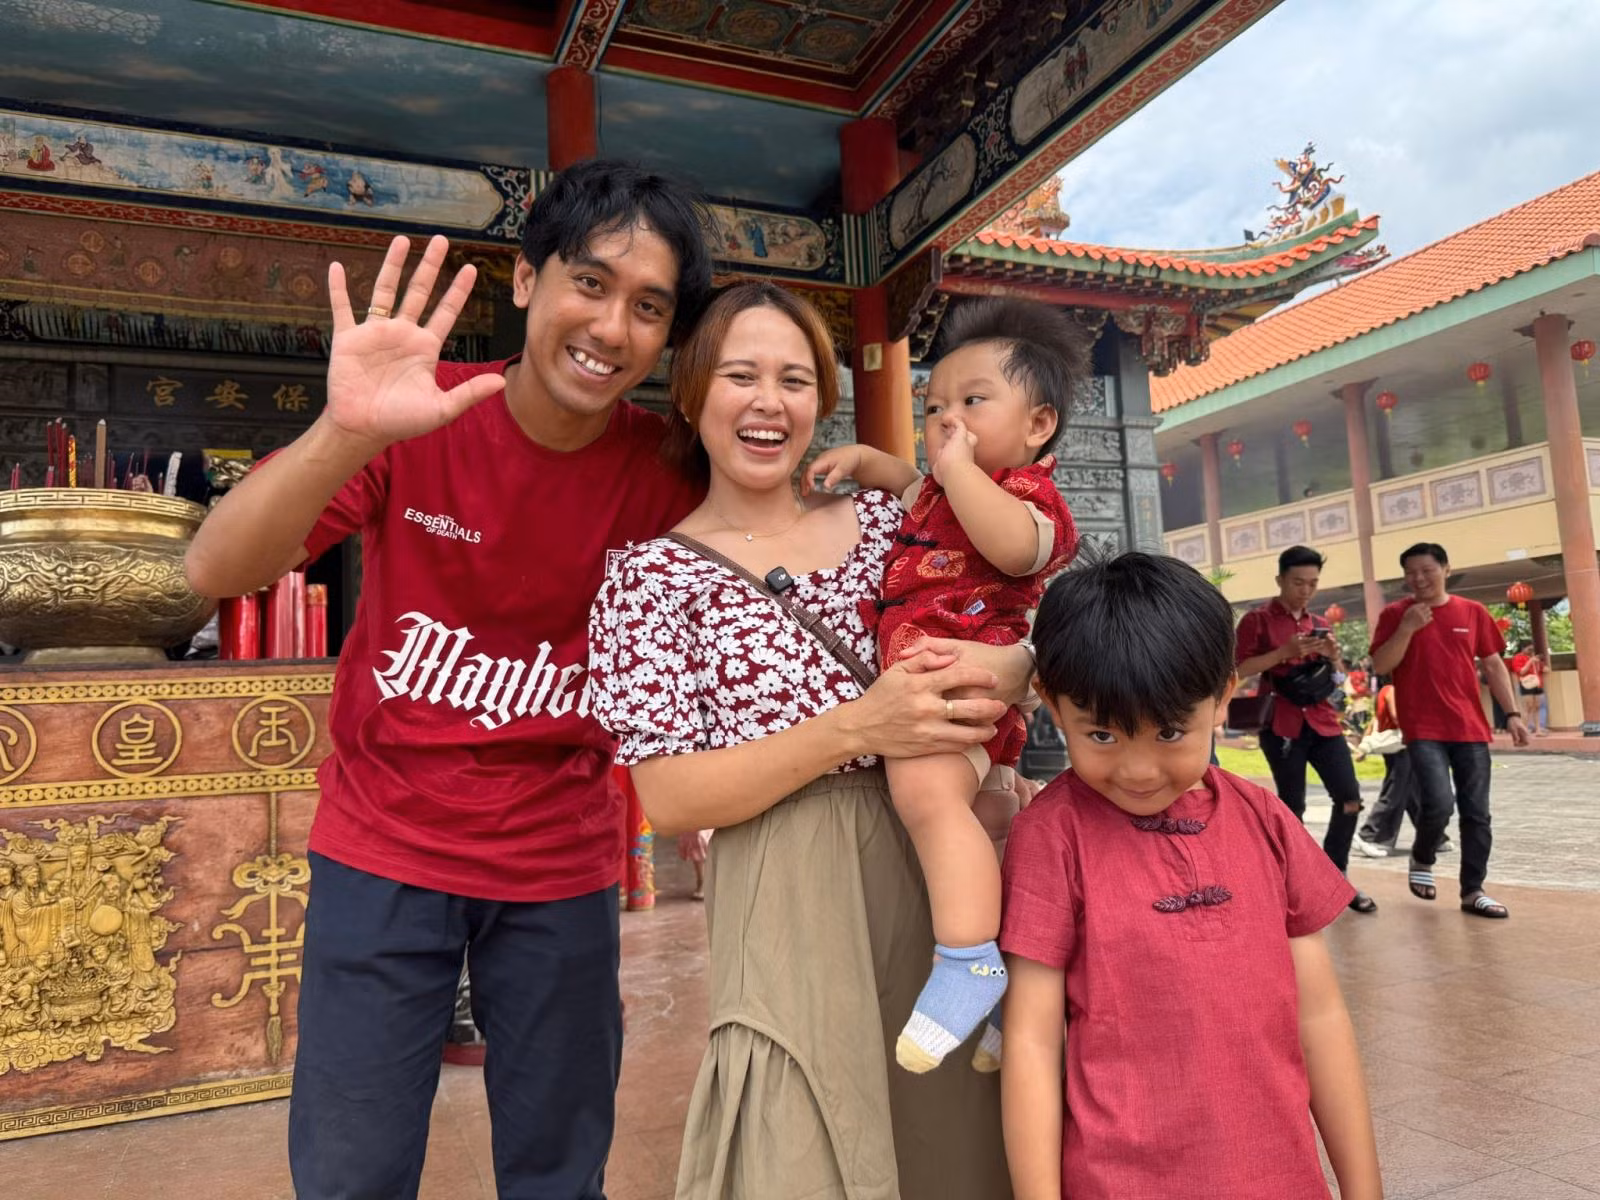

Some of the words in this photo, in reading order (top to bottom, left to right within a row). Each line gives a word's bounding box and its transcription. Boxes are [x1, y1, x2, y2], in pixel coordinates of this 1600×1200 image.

[404, 507, 482, 544] ESSENTIALS
[425, 526, 437, 534] OF
[436, 529, 458, 541] DEATH
